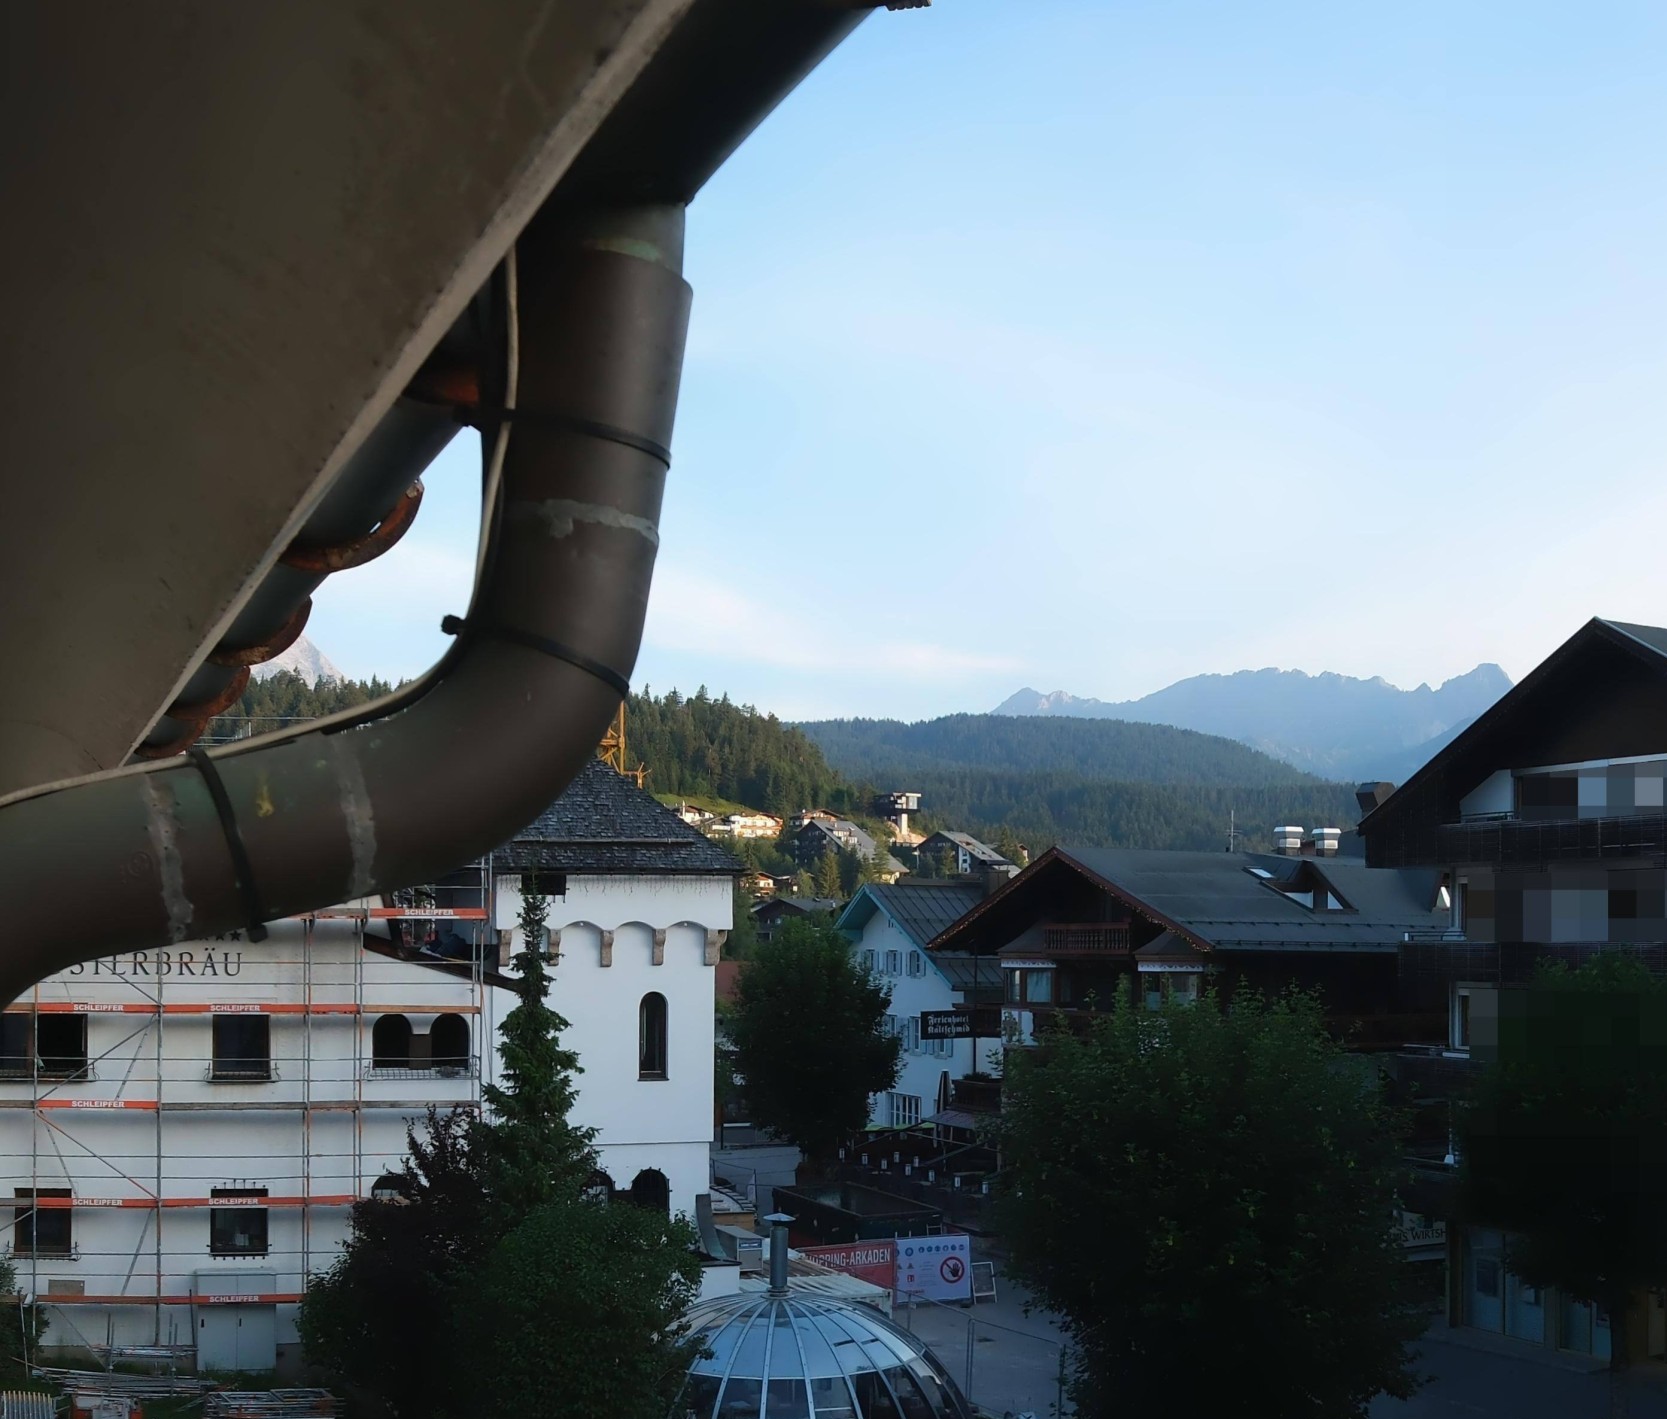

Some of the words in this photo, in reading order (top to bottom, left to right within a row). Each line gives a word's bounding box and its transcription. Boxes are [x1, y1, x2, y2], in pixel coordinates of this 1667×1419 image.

[73, 1004, 124, 1012] SCHLEIPFER
[210, 1004, 261, 1012] SCHLEIPFER
[71, 1100, 125, 1108] SCHLEIPFER
[209, 1295, 259, 1303] SCHLEIPFER
